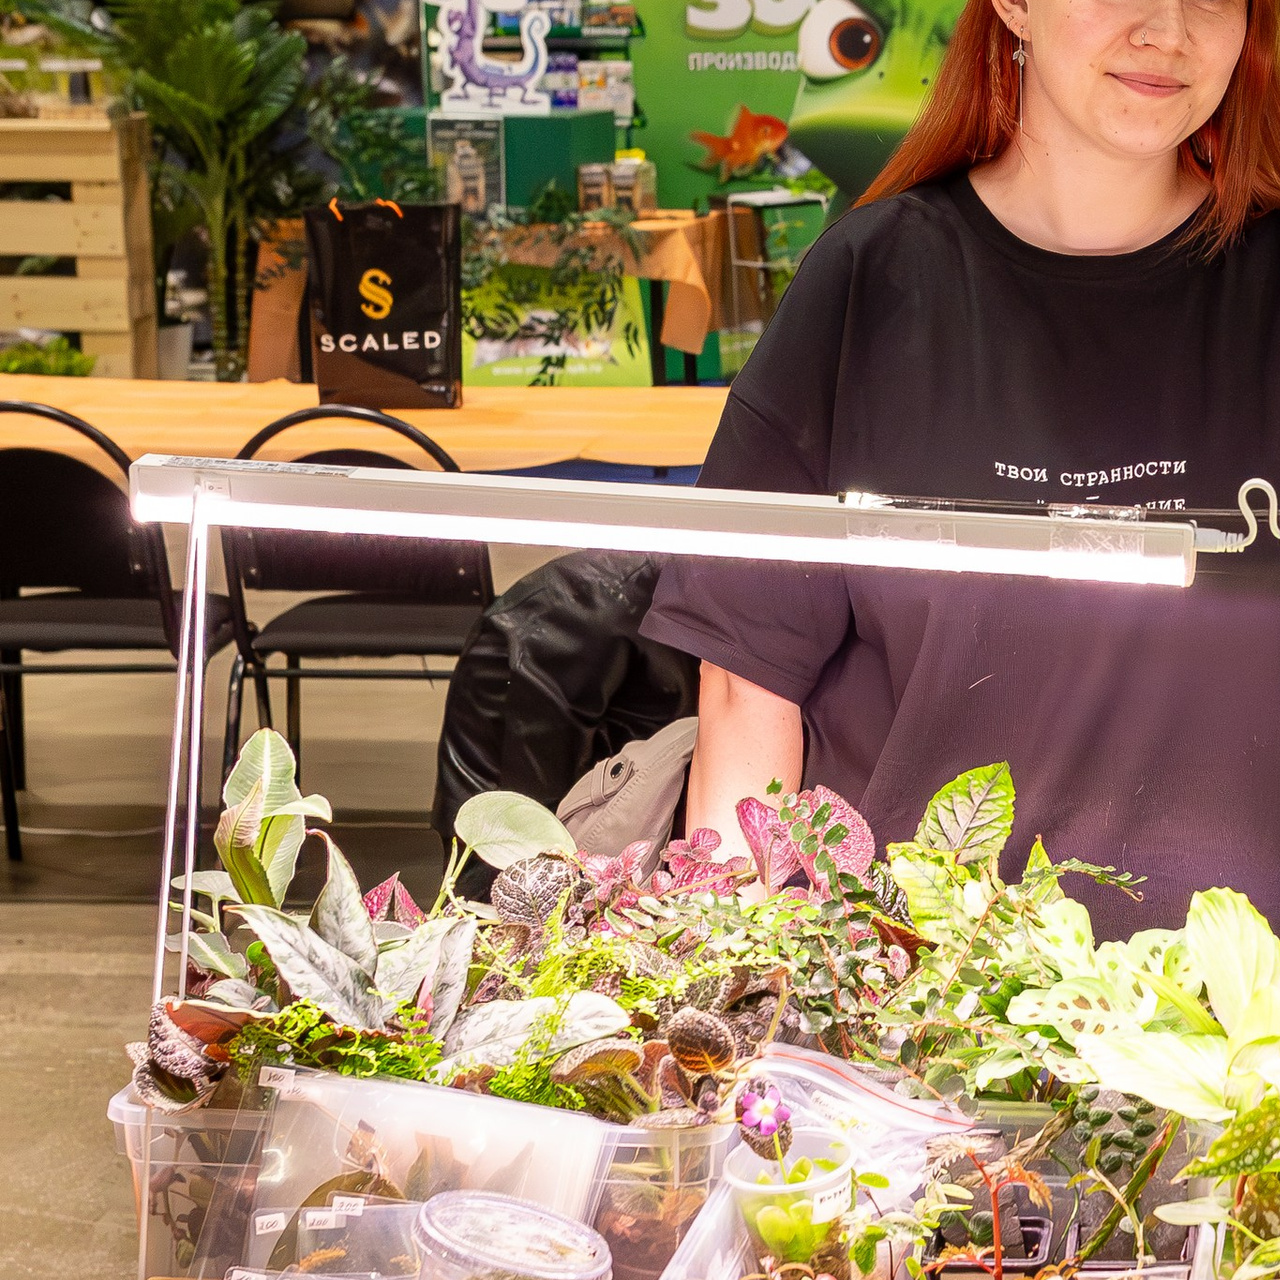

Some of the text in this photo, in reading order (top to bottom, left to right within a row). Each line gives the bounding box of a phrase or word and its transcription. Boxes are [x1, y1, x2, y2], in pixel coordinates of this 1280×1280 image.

[688, 51, 798, 72] ПРОИЗВОД
[320, 330, 441, 353] SCALED
[994, 460, 1187, 487] ТВОИ СТРАННОСТИ
